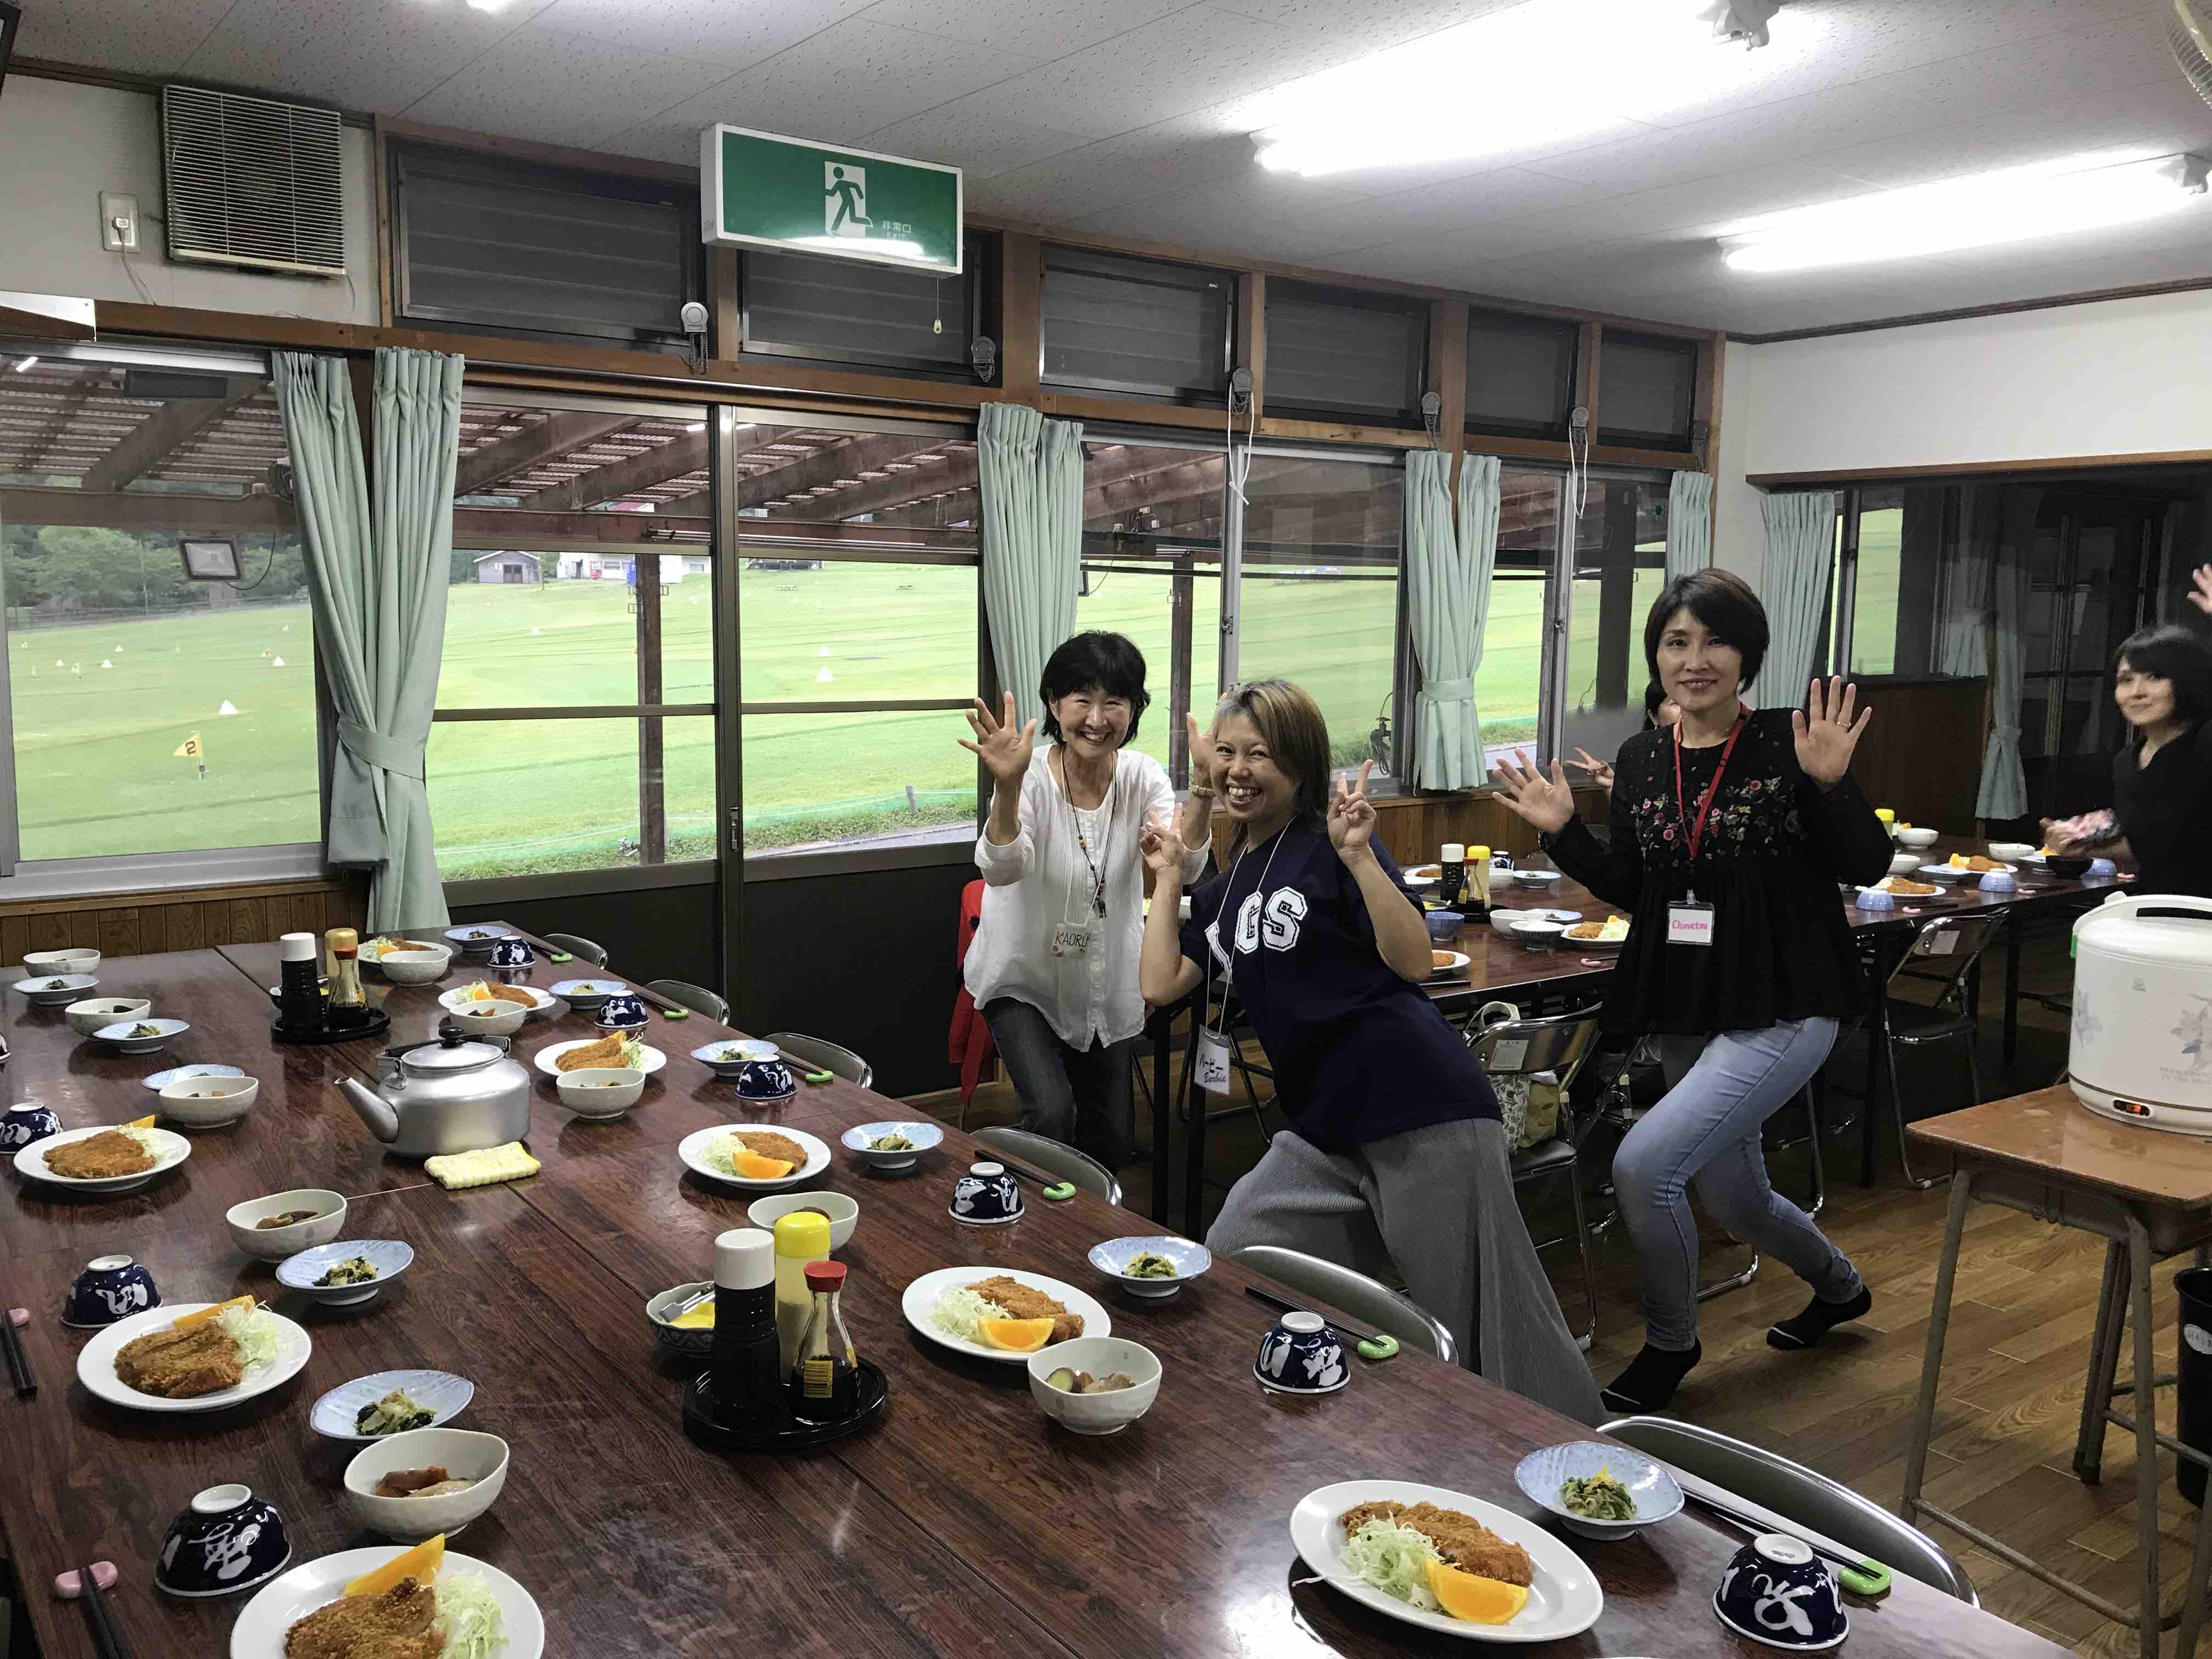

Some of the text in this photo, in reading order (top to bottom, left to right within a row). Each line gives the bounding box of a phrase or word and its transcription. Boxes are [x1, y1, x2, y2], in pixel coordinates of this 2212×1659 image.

[882, 219, 911, 233] 非常口
[185, 741, 196, 755] 2
